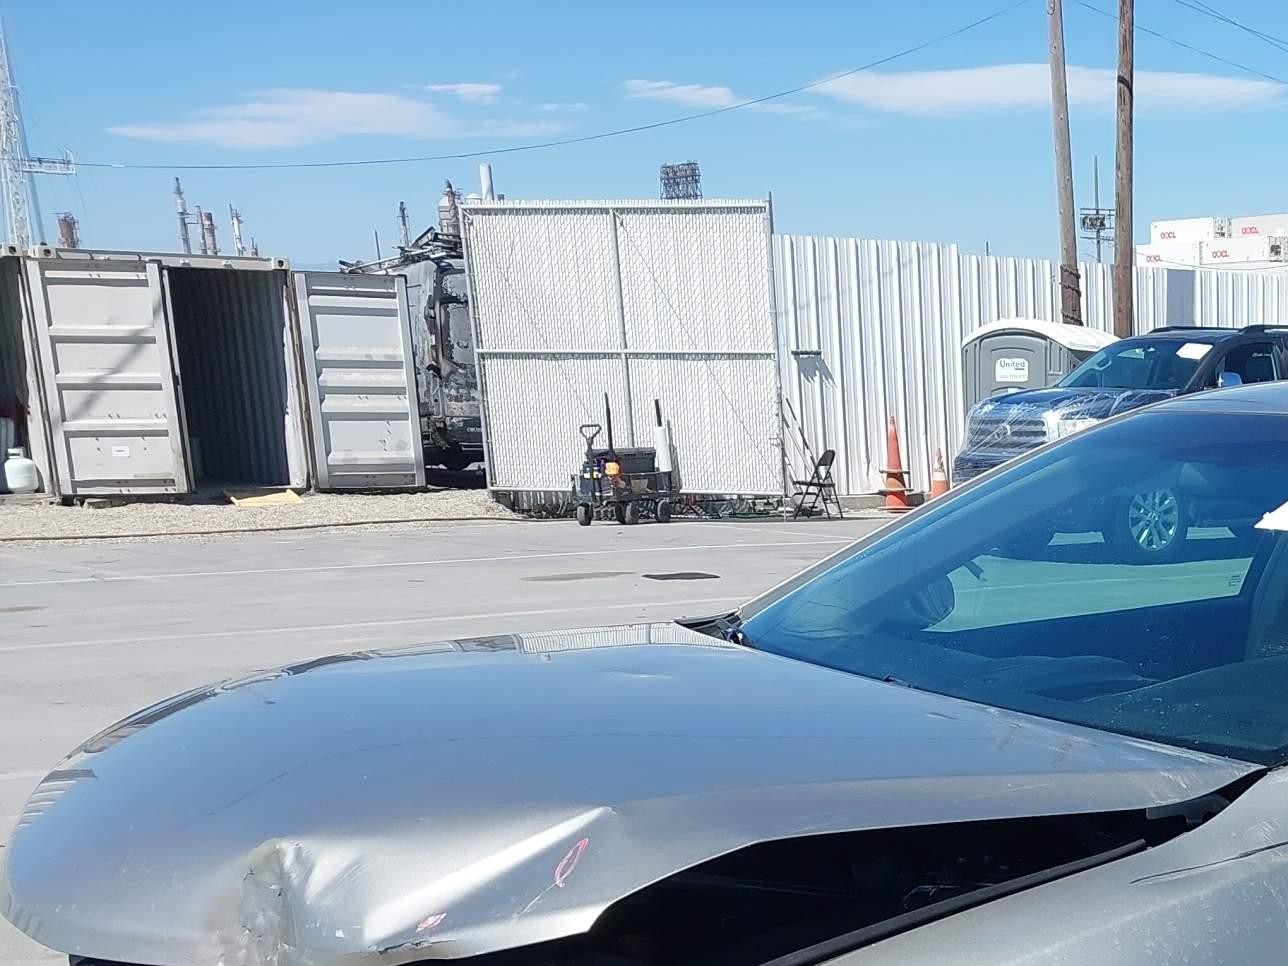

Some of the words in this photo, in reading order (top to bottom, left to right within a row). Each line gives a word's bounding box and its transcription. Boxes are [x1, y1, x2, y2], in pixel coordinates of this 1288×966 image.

[1241, 226, 1260, 236] OOCL
[1211, 250, 1230, 259] OOCL
[999, 359, 1026, 368] United
